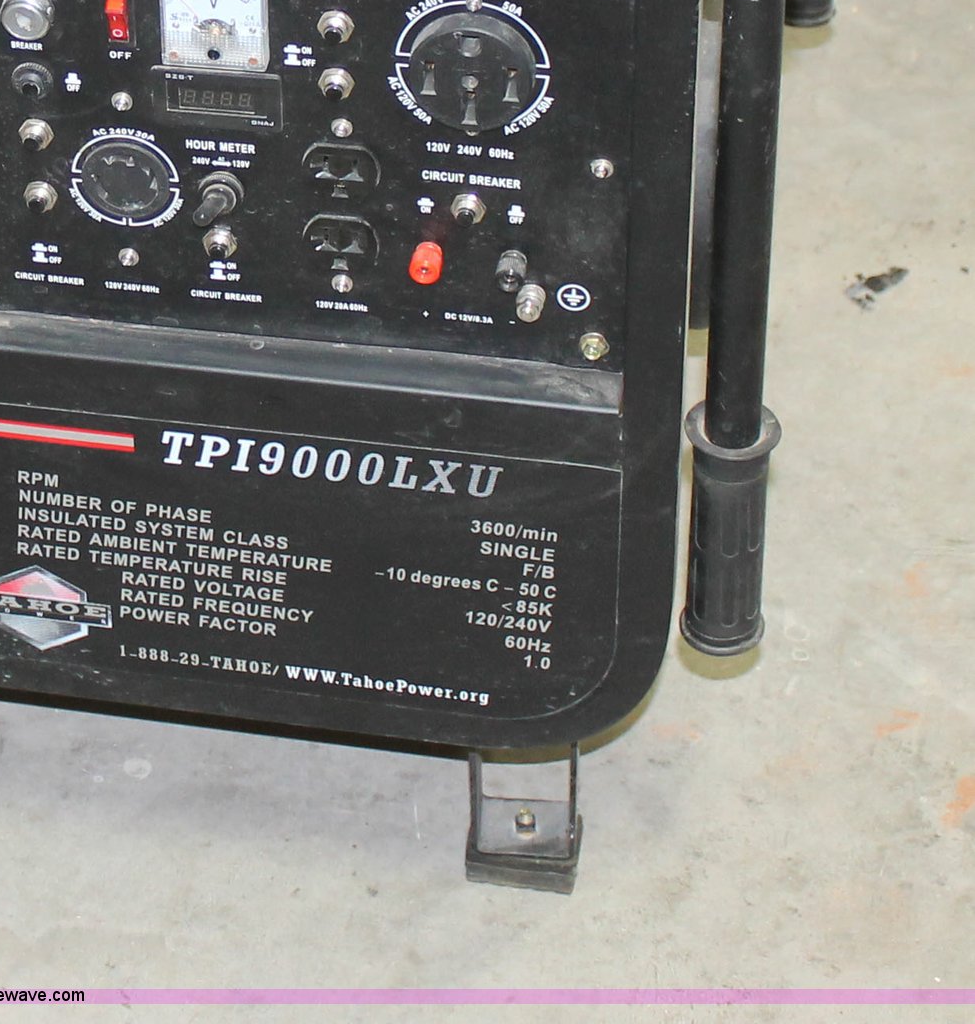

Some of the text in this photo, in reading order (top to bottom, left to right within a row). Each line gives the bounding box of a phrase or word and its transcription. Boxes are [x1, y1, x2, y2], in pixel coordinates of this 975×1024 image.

[405, 5, 421, 21] AC
[501, 0, 523, 17] 50A
[10, 41, 43, 52] BREAKER
[109, 50, 132, 60] OFF
[185, 139, 256, 155] HOUR METER
[426, 141, 515, 161] 120V 240V 60Hz
[421, 169, 521, 190] CIRCUIT BREAKER
[14, 271, 85, 286] CIRCUIT BREAKER
[160, 429, 505, 498] TPI9000LXU
[17, 470, 60, 488] RPM
[18, 489, 213, 524] NUMBER OF PHASE
[17, 506, 290, 551] INSULATED SYSTEM CLASS
[470, 519, 558, 543] 3600/min
[479, 541, 556, 563] SINGLE
[522, 562, 556, 580] F/B
[121, 571, 285, 603] RATED VOLTAGE
[120, 588, 314, 624] RATED FREQUENCY
[515, 599, 553, 617] 85K
[118, 606, 277, 637] POWER FACTOR
[465, 611, 552, 633] 120/240V
[504, 635, 552, 654] 60Hz
[523, 654, 551, 670] 1.0
[284, 664, 490, 706] WWW.TahoePower.org
